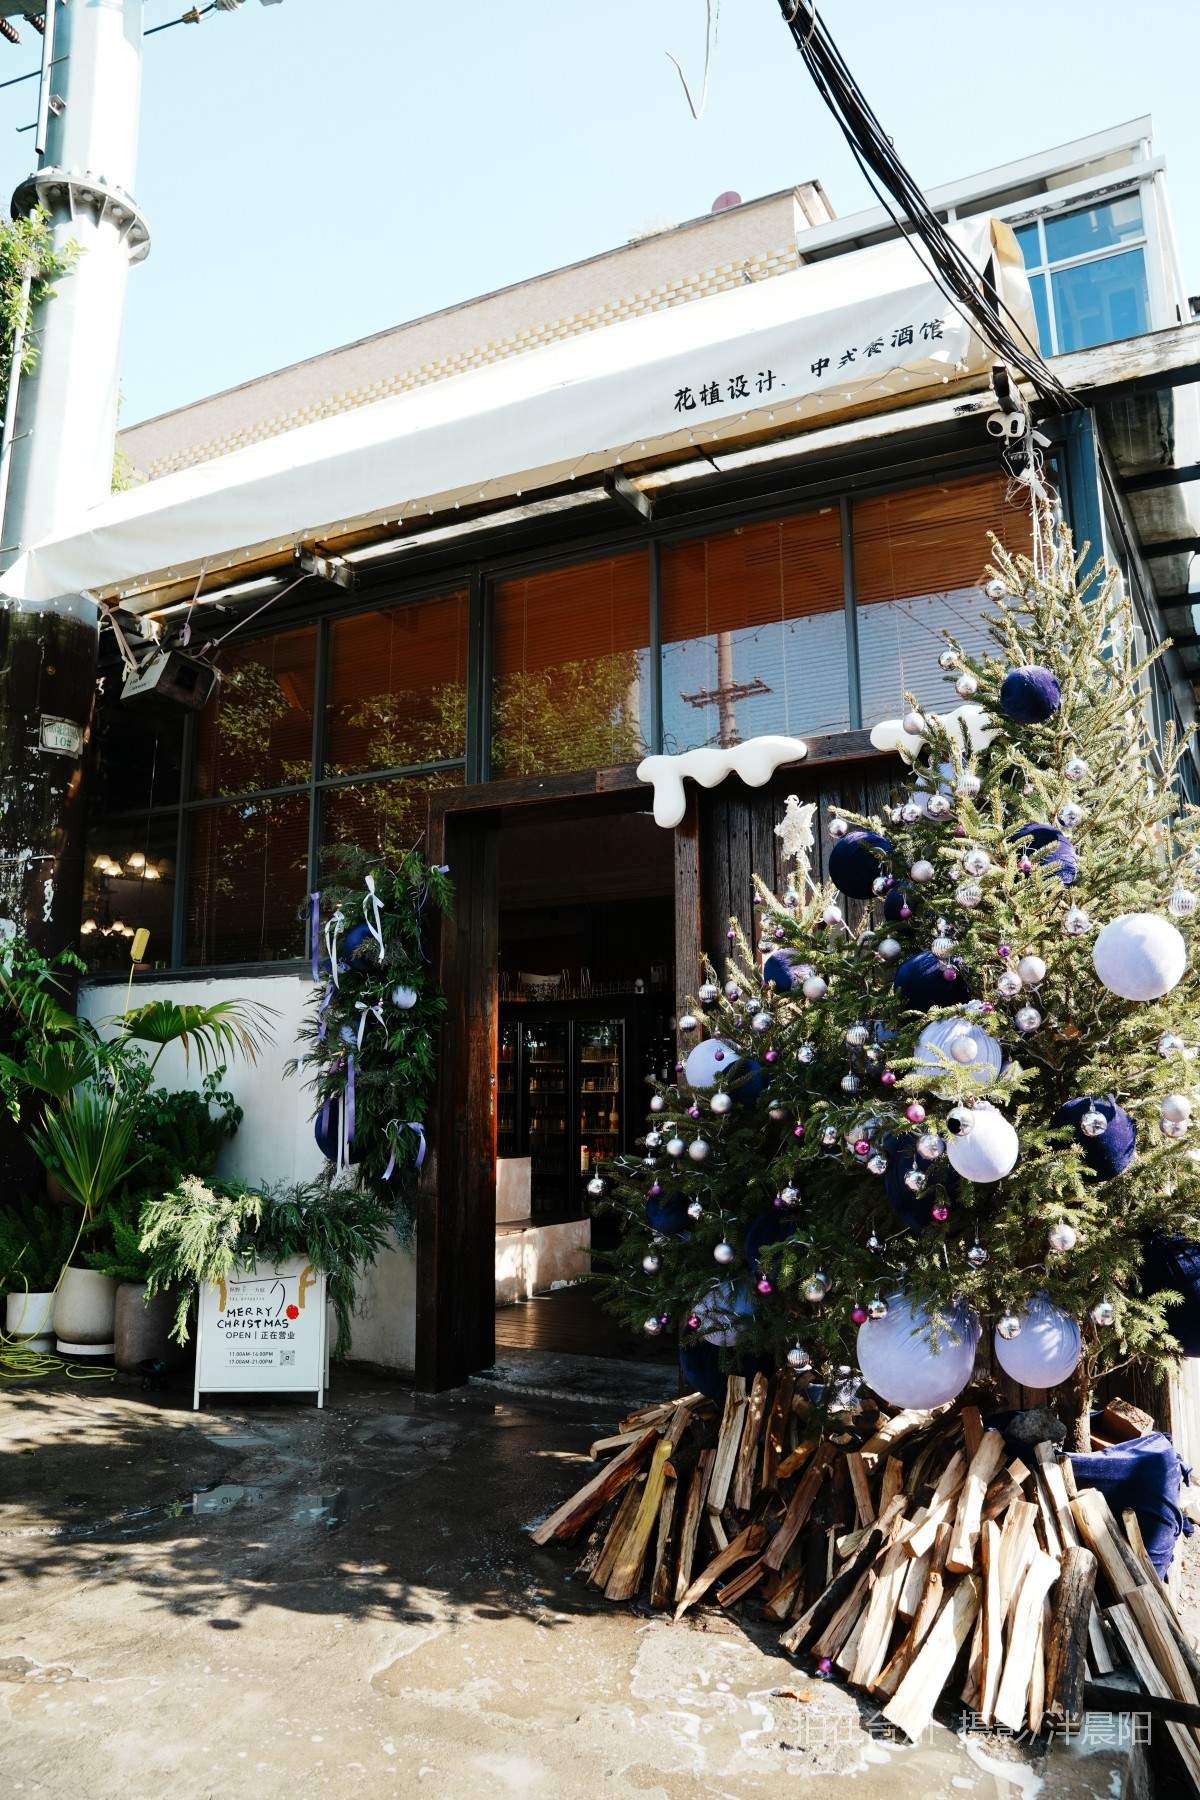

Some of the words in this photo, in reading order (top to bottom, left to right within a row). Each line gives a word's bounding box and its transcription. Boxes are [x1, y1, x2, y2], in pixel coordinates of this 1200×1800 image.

[810, 318, 945, 378] 中式餐酒馆
[226, 1307, 273, 1318] MERRY
[216, 1318, 289, 1329] CHRISTMAS
[225, 1331, 251, 1339] OPEN
[260, 1331, 296, 1340] 正在营业
